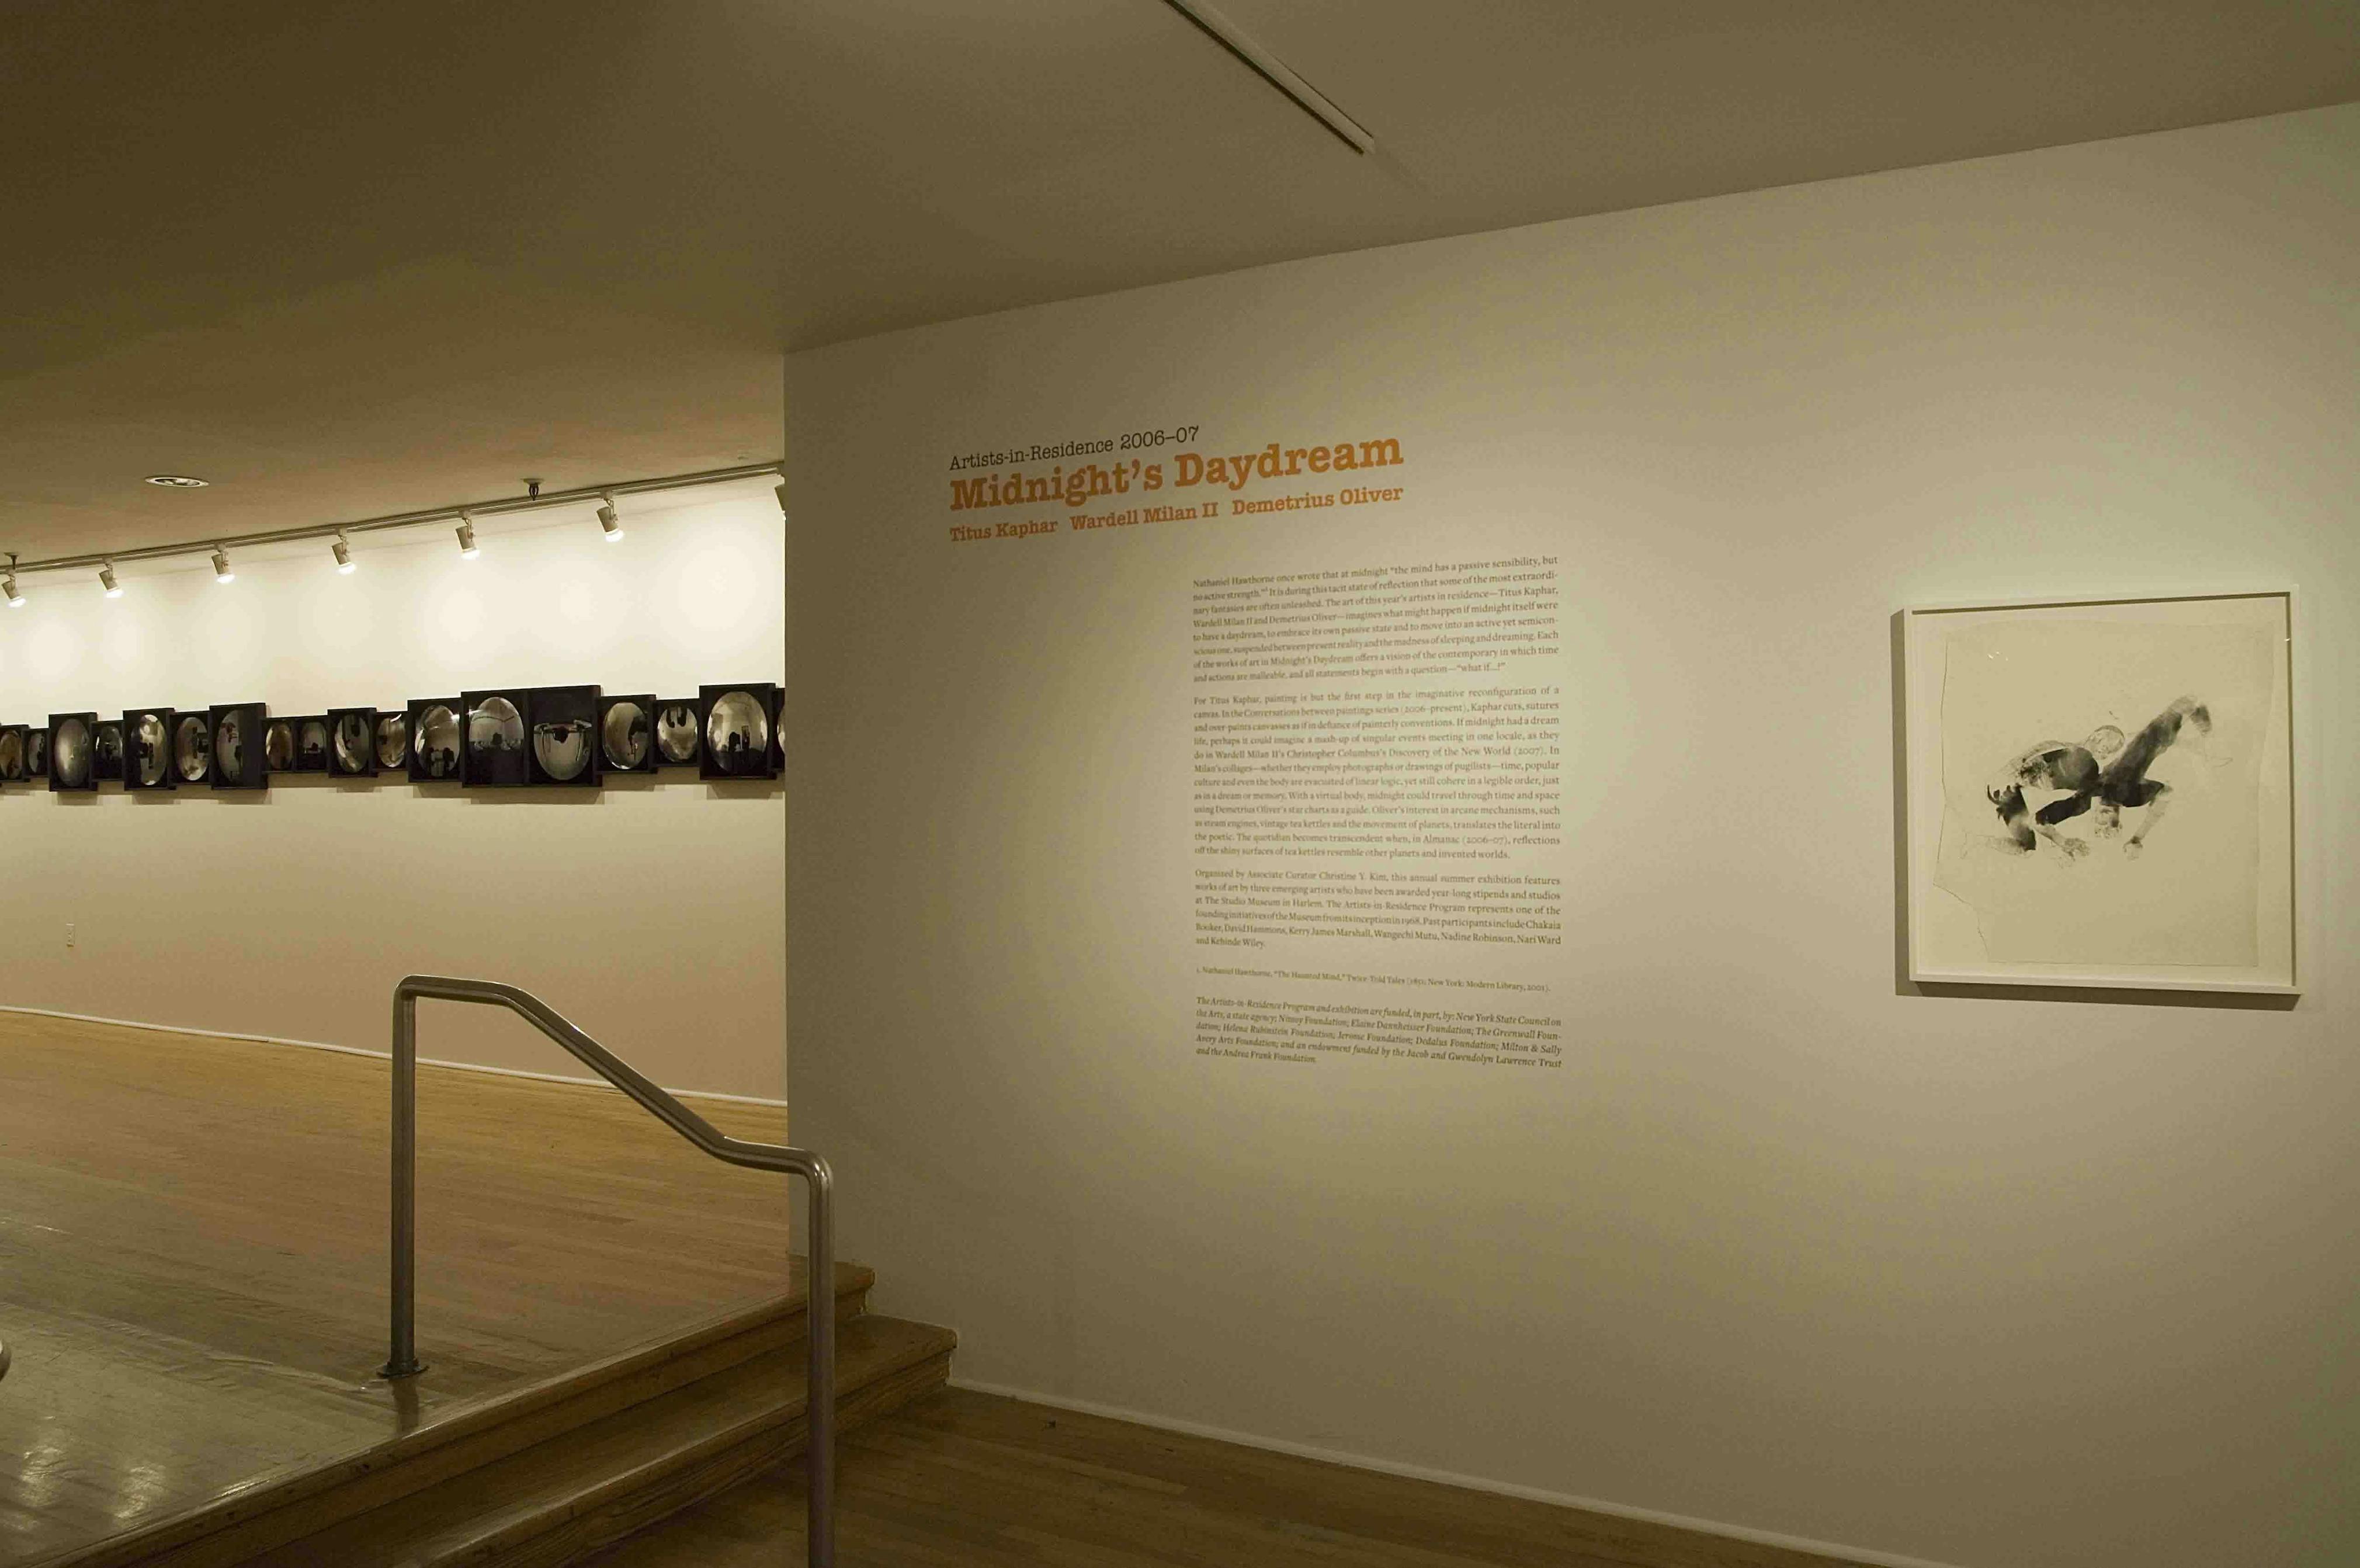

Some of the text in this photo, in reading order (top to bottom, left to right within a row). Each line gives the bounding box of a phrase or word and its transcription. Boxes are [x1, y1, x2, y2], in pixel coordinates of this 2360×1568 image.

[949, 425, 1199, 470] Artists-in-Residence 2006–07
[949, 437, 1404, 511] Midnight’s Daydream
[949, 486, 1404, 542] Titus Kaphar Wardell Milan II Demetrius Oliver
[1193, 577, 1230, 587] Nathaniel
[1232, 575, 1275, 585] Hawthorne
[1297, 572, 1320, 581] wrote
[1322, 570, 1338, 579] that
[1341, 570, 1349, 578] at
[1351, 566, 1388, 578] midnight
[1411, 563, 1433, 573] mind
[1435, 562, 1449, 571] has
[1459, 560, 1490, 572] passive
[1492, 556, 1540, 568] sensibility,
[1542, 555, 1558, 564] but
[1193, 660, 1201, 668] of
[1203, 659, 1214, 668] the
[1216, 658, 1238, 667] works
[1240, 658, 1247, 667] of
[1261, 657, 1269, 665] in
[1313, 654, 1353, 665] Daydream
[1355, 653, 1379, 662] offers
[1386, 651, 1411, 661] vision
[1412, 650, 1421, 660] of
[1422, 650, 1436, 659] the
[1438, 650, 1498, 660] contemporary
[1500, 647, 1508, 656] in
[1510, 645, 1537, 655] which
[1538, 646, 1559, 654] time
[1194, 696, 1206, 705] For
[1210, 696, 1230, 704] Titus
[1265, 694, 1297, 705] painting
[1300, 693, 1307, 702] is
[1310, 692, 1324, 701] but
[1327, 692, 1341, 700] the
[1344, 691, 1361, 700] first
[1365, 692, 1383, 702] step
[1386, 691, 1394, 699] in
[1398, 689, 1411, 699] the
[1415, 689, 1464, 700] imaginative
[1469, 686, 1537, 698] reconfiguration
[1540, 685, 1550, 695] of
[1195, 845, 1205, 854] off
[1206, 845, 1219, 854] the
[1220, 845, 1240, 856] shiny
[1242, 846, 1273, 855] surfaces
[1275, 846, 1283, 855] of
[1298, 847, 1325, 856] kettles
[1327, 847, 1363, 856] resemble
[1365, 848, 1387, 857] other
[1389, 848, 1420, 859] planets
[1421, 848, 1437, 858] and
[1439, 849, 1476, 858] invented
[1235, 869, 1244, 880] by
[1248, 870, 1283, 879] Associate
[1285, 870, 1317, 879] Curator
[1318, 870, 1356, 880] Christine
[1391, 872, 1407, 882] this
[1410, 873, 1438, 882] annual
[1477, 874, 1522, 884] exhibition
[1525, 875, 1560, 885] features
[1205, 895, 1219, 904] The
[1221, 896, 1246, 905] Studio
[1248, 897, 1280, 906] Museum
[1282, 898, 1290, 906] in
[1326, 899, 1342, 908] The
[1429, 903, 1466, 914] Program
[1468, 906, 1514, 915] represents
[1535, 905, 1544, 914] of
[1546, 905, 1561, 915] the
[1224, 924, 1246, 932] David
[1289, 926, 1310, 937] Kerry
[1311, 927, 1335, 936] James
[1441, 931, 1471, 941] Nadine
[1517, 934, 1536, 943] Nari
[1538, 935, 1561, 945] Ward
[1196, 995, 1210, 1005] The
[1283, 1001, 1315, 1012] Program
[1316, 1003, 1331, 1012] and
[1331, 1004, 1369, 1015] exhibition
[1413, 1009, 1421, 1018] in
[1456, 1012, 1474, 1021] New
[1476, 1013, 1495, 1022] York
[1496, 1014, 1516, 1024] State
[1518, 1015, 1550, 1026] Council
[1218, 1035, 1234, 1044] Arts
[1280, 1039, 1295, 1049] and
[1308, 1041, 1351, 1053] endowment
[1353, 1044, 1379, 1054] funded
[1382, 1046, 1391, 1057] by
[1393, 1047, 1405, 1056] the
[1407, 1049, 1429, 1058] Jacob
[1431, 1050, 1446, 1060] and
[1448, 1052, 1494, 1065] Gwendolyn
[1496, 1054, 1536, 1066] Lawrence
[1538, 1057, 1562, 1068] Trust
[1338, 1031, 1365, 1040] Jerome
[1531, 1043, 1538, 1052] &
[1540, 1044, 1562, 1056] Sally
